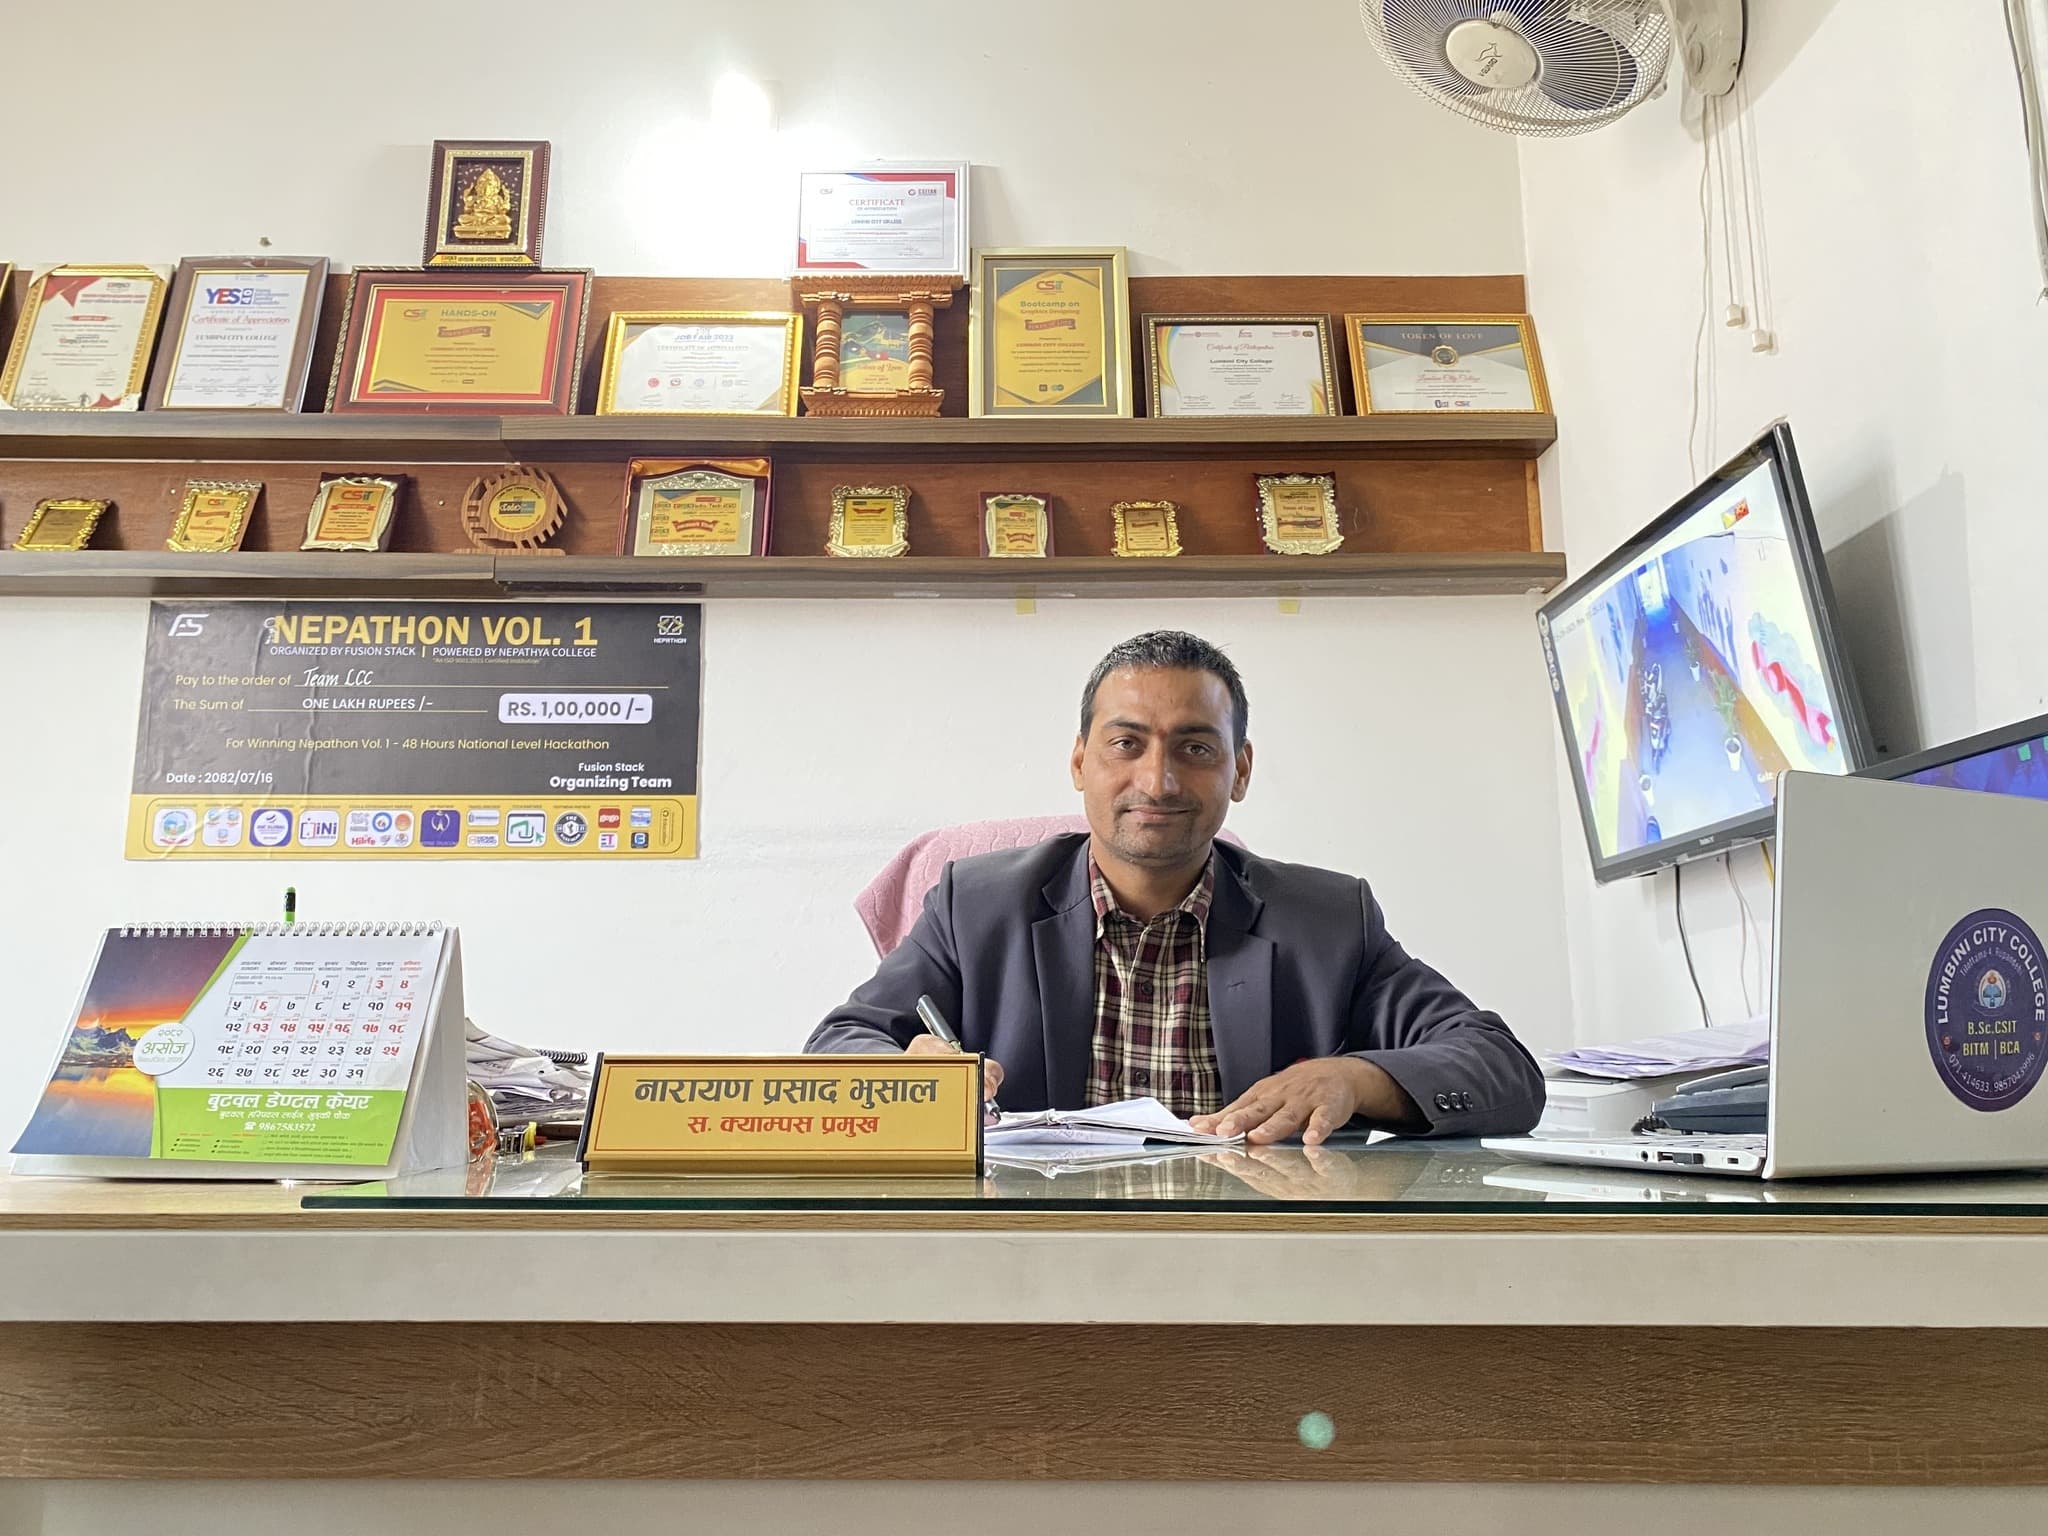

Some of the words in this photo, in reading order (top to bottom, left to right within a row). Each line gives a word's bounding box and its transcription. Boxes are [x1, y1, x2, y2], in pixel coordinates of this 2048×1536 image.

[206, 288, 241, 304] YES
[441, 309, 497, 317] HANDS-ON
[274, 614, 469, 645] NEPATHON
[481, 616, 561, 646] VOL.
[573, 616, 598, 646] 1
[270, 646, 328, 656] ORGANIZED
[330, 647, 344, 656] BY
[344, 647, 382, 656] FUSION
[384, 647, 416, 656] STACK
[432, 648, 482, 657] POWERED
[484, 648, 497, 657] BY
[499, 648, 550, 657] NEPATHYA
[552, 648, 597, 658] COLLEGE
[175, 675, 198, 688] Pay
[202, 674, 214, 686] to
[218, 674, 239, 686] the
[241, 674, 275, 686] order
[278, 674, 291, 686] of
[303, 667, 339, 686] Team
[344, 668, 374, 686] LCC
[174, 699, 197, 710] The
[199, 699, 229, 710] Sum
[231, 699, 245, 710] of
[302, 698, 330, 709] ONE
[332, 698, 366, 709] LAKH
[368, 698, 416, 709] RUPEES
[418, 696, 434, 711] /-
[507, 701, 536, 716] RS.
[541, 701, 621, 719] 1,00,000
[625, 697, 644, 720] /-
[226, 738, 243, 749] For
[247, 738, 296, 751] Winning
[299, 738, 359, 751] Nepathon
[361, 739, 382, 749] Vol.
[385, 739, 389, 749] 1
[402, 739, 418, 750] 48
[420, 739, 455, 750] Hours
[457, 739, 508, 750] National
[511, 739, 541, 750] Level
[544, 739, 610, 750] Hackathon
[578, 762, 612, 772] Fusion
[615, 762, 645, 772] Stack
[166, 772, 196, 784] Date
[204, 771, 273, 785] 2082/07/16
[549, 776, 628, 791] Organizing
[631, 776, 672, 789] Team
[1937, 938, 1971, 1025] LUMBINI
[1973, 926, 2007, 945] CITY
[2010, 935, 2045, 1022] COLLEGE
[347, 980, 356, 988] २
[375, 980, 384, 989] ३
[232, 1001, 242, 1011] ५
[286, 1001, 296, 1010] ७
[367, 1001, 384, 1011] १०
[395, 1001, 412, 1011] ११
[225, 1023, 242, 1032] १२
[252, 1023, 269, 1032] १३
[279, 1023, 297, 1032] १४
[307, 1023, 325, 1033] १५
[334, 1023, 351, 1033] १६
[362, 1023, 379, 1033] १७
[1967, 1020, 2017, 1035] B.Sc.CSIT
[142, 1037, 188, 1055] असोज
[245, 1045, 262, 1055] २०
[271, 1045, 289, 1055] २१
[299, 1045, 317, 1055] २२
[327, 1046, 345, 1055] २३
[354, 1046, 372, 1055] २४
[383, 1046, 400, 1056] २५
[1962, 1042, 1989, 1056] BITM
[2000, 1040, 2020, 1055] BCA
[207, 1067, 225, 1078] २६
[235, 1068, 253, 1078] २७
[263, 1068, 281, 1078] २८
[319, 1068, 337, 1078] ३०
[346, 1068, 364, 1078] ३१
[635, 1078, 753, 1103] नारायण
[763, 1078, 841, 1106] प्रसाद
[849, 1078, 938, 1110] भुसाल
[207, 1093, 261, 1111] बुटवल
[265, 1092, 320, 1109] डेण्टल
[325, 1092, 372, 1110] केयर
[687, 1116, 712, 1134] स.
[720, 1116, 813, 1133] क्याम्पस
[821, 1116, 881, 1137] प्रमुख
